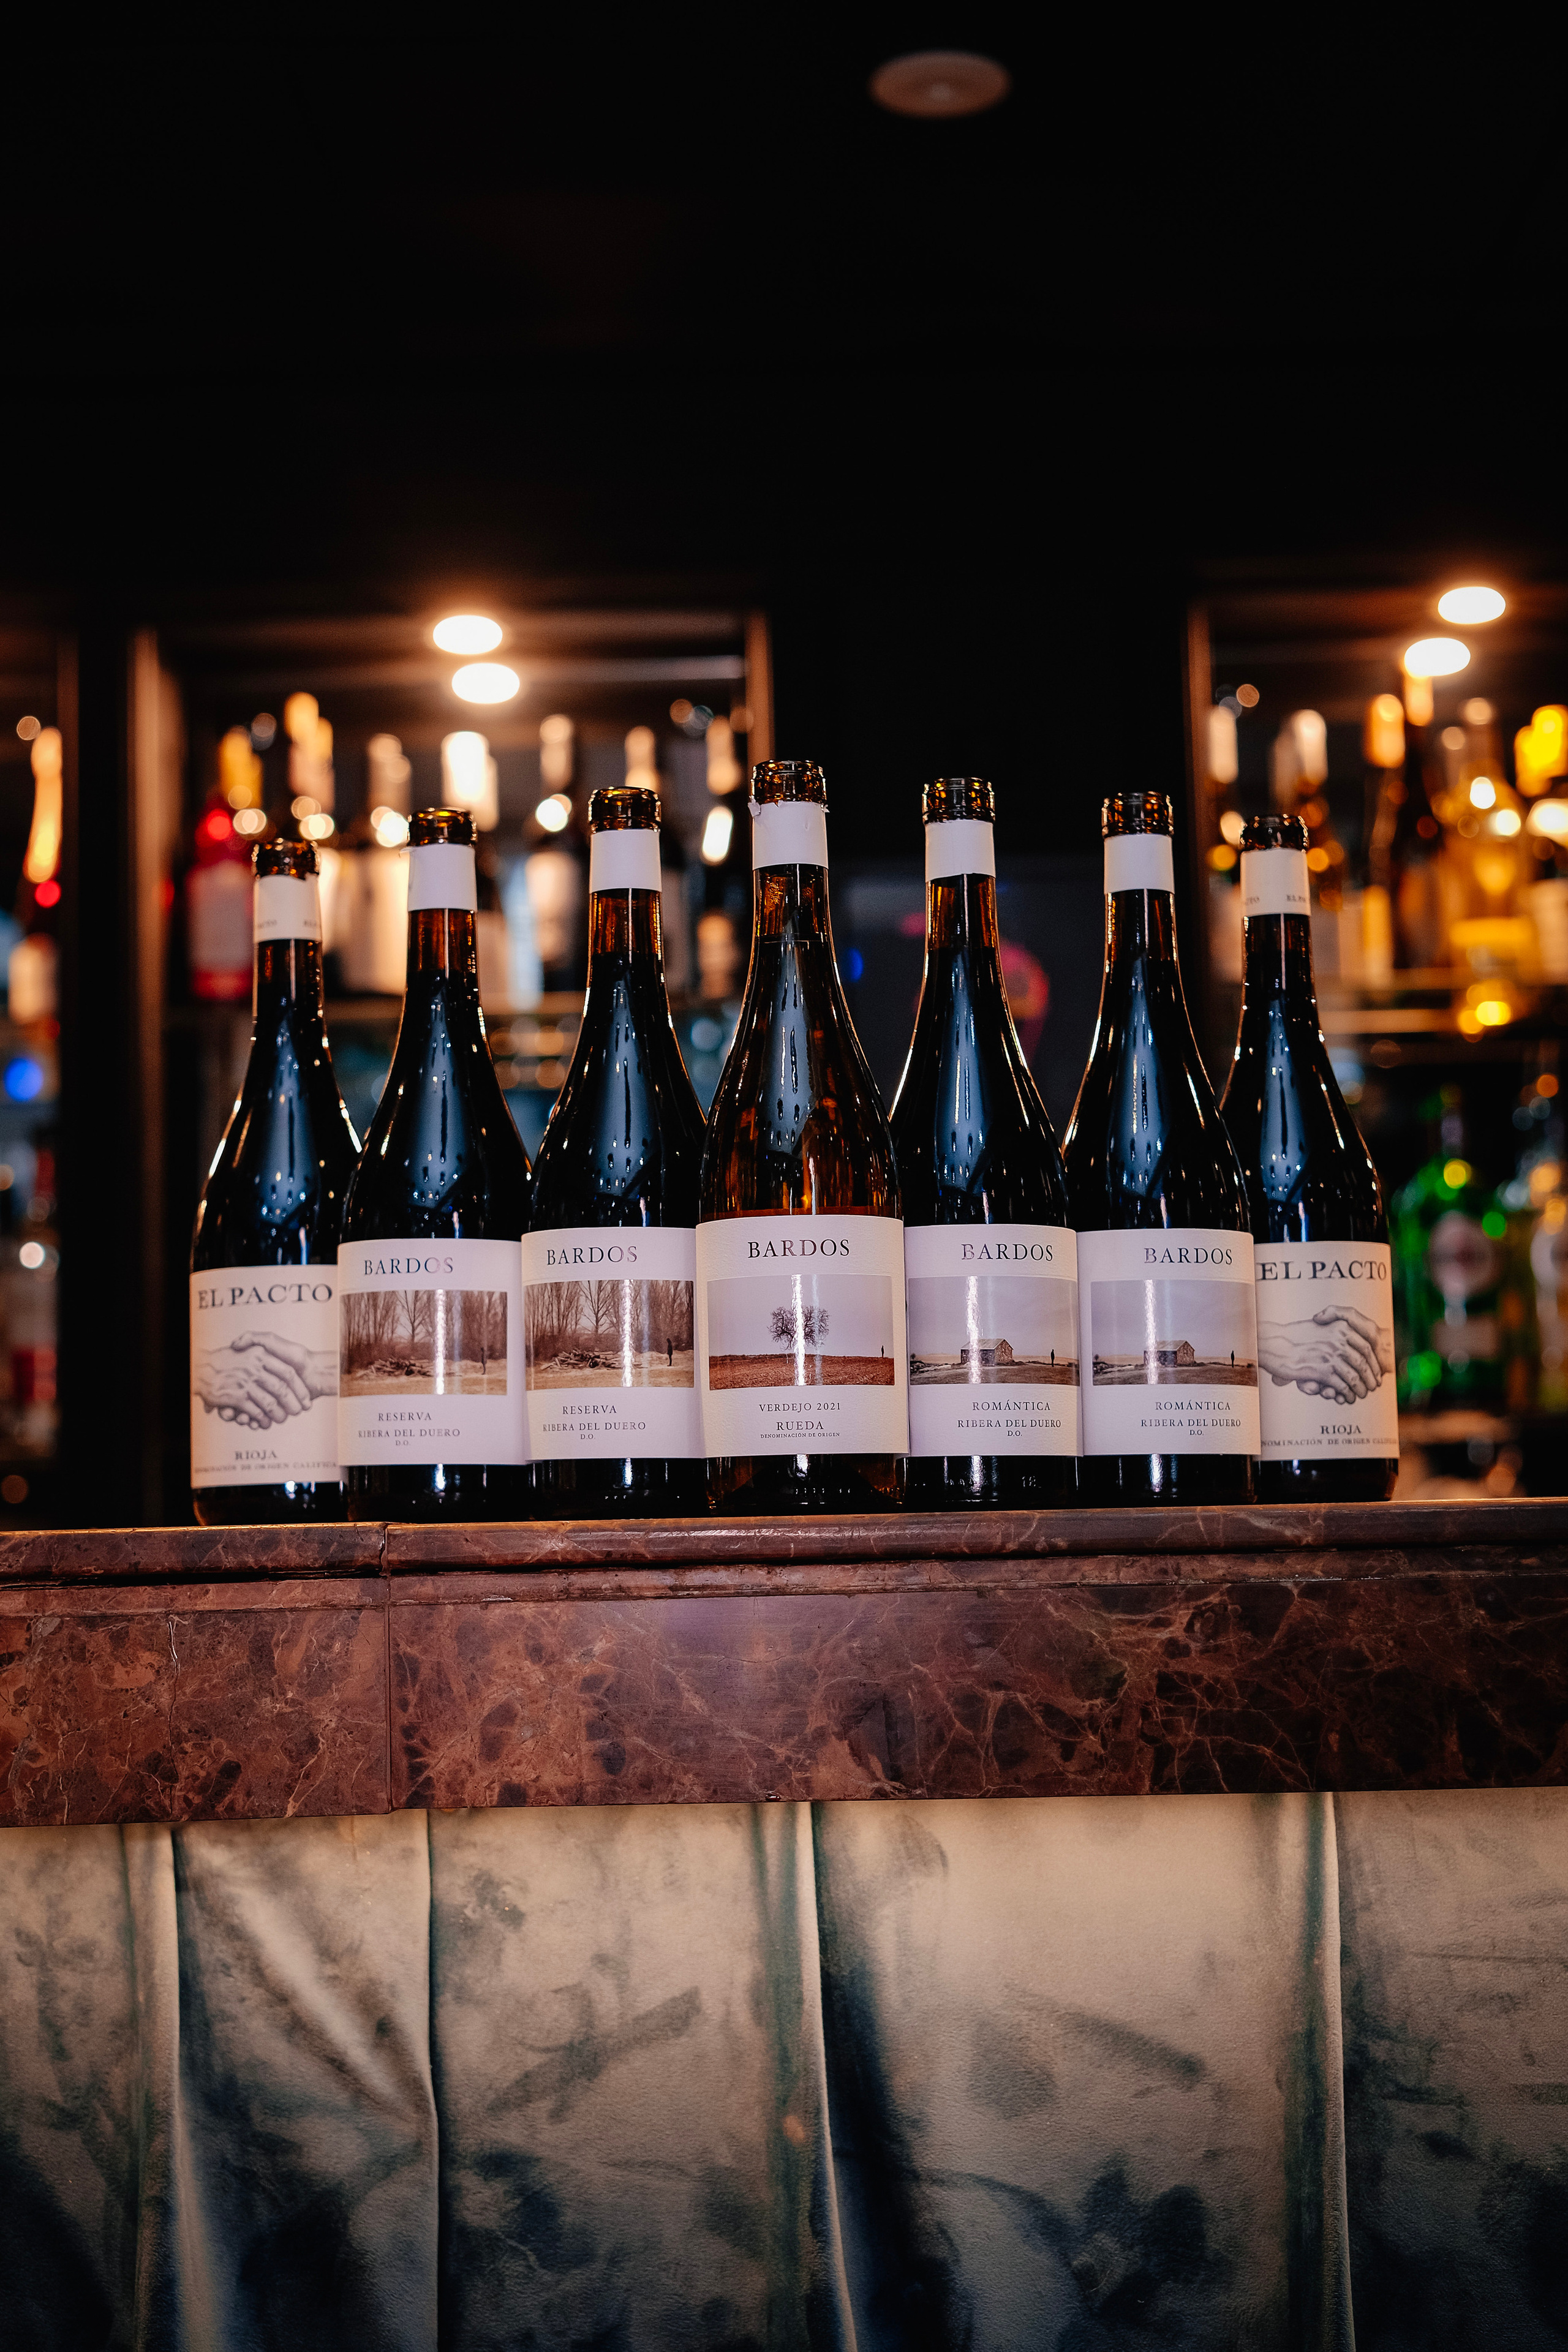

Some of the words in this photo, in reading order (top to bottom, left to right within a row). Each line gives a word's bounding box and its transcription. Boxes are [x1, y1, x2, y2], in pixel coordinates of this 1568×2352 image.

[748, 1238, 850, 1258] BARDOS
[961, 1243, 1053, 1262] BARDOS
[547, 1246, 638, 1265] BARDOS
[1144, 1247, 1232, 1265] BARDOS
[364, 1257, 454, 1275] BARDOS
[1256, 1262, 1302, 1280] EL
[1306, 1260, 1387, 1281] PACTO
[198, 1288, 224, 1310] EL
[228, 1283, 333, 1307] PACTO
[562, 1405, 617, 1415] RESERVA
[759, 1403, 812, 1413] VERDEJO
[816, 1402, 840, 1411] 2021
[972, 1399, 1051, 1411] ROMÁNTICA
[1155, 1400, 1231, 1411] ROMÁNTICA
[378, 1412, 432, 1422] RESERVA
[543, 1423, 575, 1432] RIBERA
[579, 1422, 600, 1431] DEL
[605, 1422, 646, 1431] DUERO
[776, 1420, 824, 1431] RUEDA
[1188, 1419, 1208, 1427] DEL
[1212, 1419, 1242, 1427] DUERO
[358, 1430, 390, 1438] RIBERA
[394, 1429, 415, 1438] DEL
[420, 1428, 461, 1438] DUERO
[1321, 1425, 1362, 1435] RIOJA
[235, 1450, 277, 1460] RIOJA
